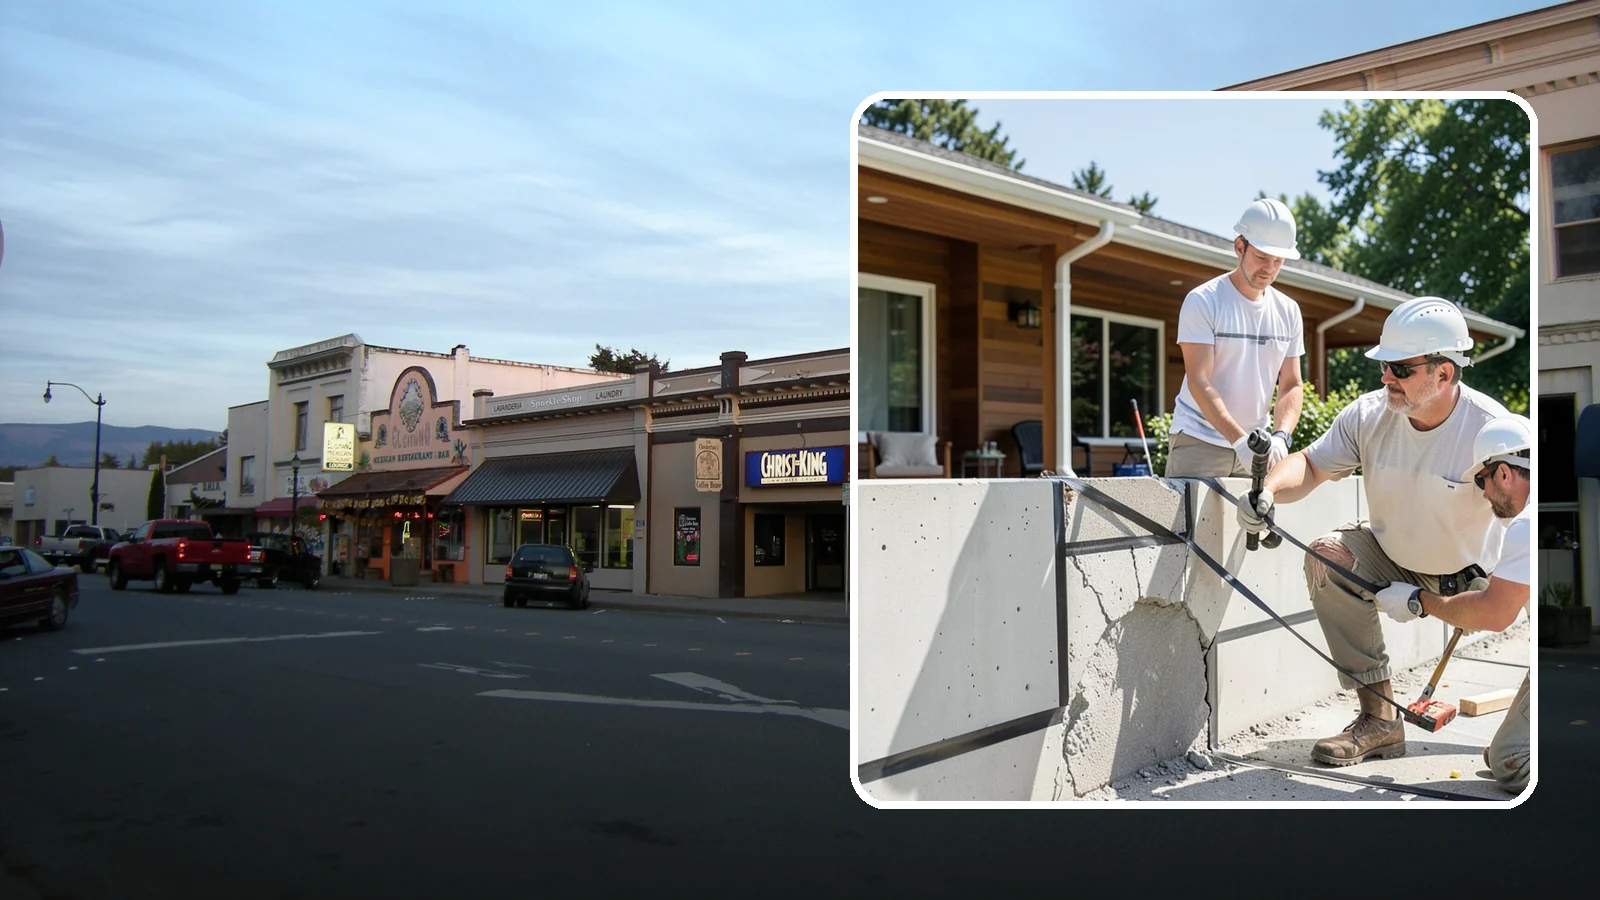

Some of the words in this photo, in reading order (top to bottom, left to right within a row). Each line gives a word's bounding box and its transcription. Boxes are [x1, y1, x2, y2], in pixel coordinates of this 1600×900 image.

[493, 402, 523, 412] LAVANDERIA
[530, 397, 561, 409] Sparkle
[561, 395, 582, 404] Shop
[595, 389, 624, 400] LAUNDRY
[373, 455, 396, 464] MEXICAN
[397, 451, 433, 462] RESTAURANT
[437, 450, 450, 459] BAR
[760, 452, 797, 478] CHRIST
[799, 450, 827, 477] KING
